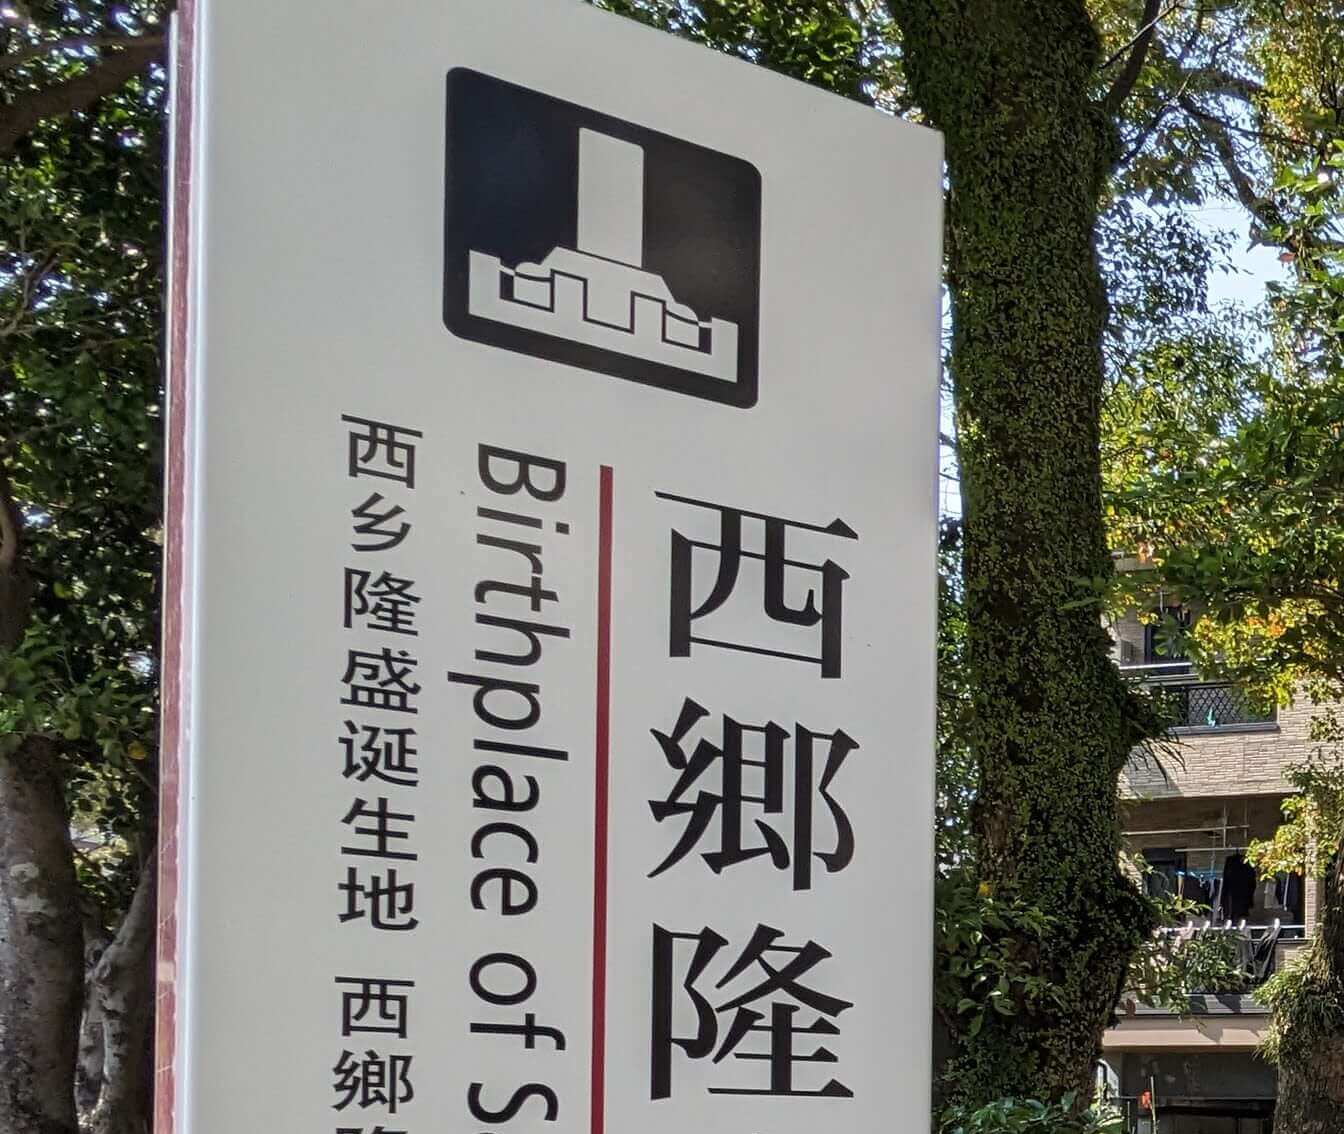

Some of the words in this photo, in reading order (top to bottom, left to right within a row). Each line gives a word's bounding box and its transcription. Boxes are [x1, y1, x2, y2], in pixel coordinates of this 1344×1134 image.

[334, 412, 424, 932] 西乡隆盛诞生地
[448, 443, 572, 916] Birthplace
[468, 952, 566, 1051] of
